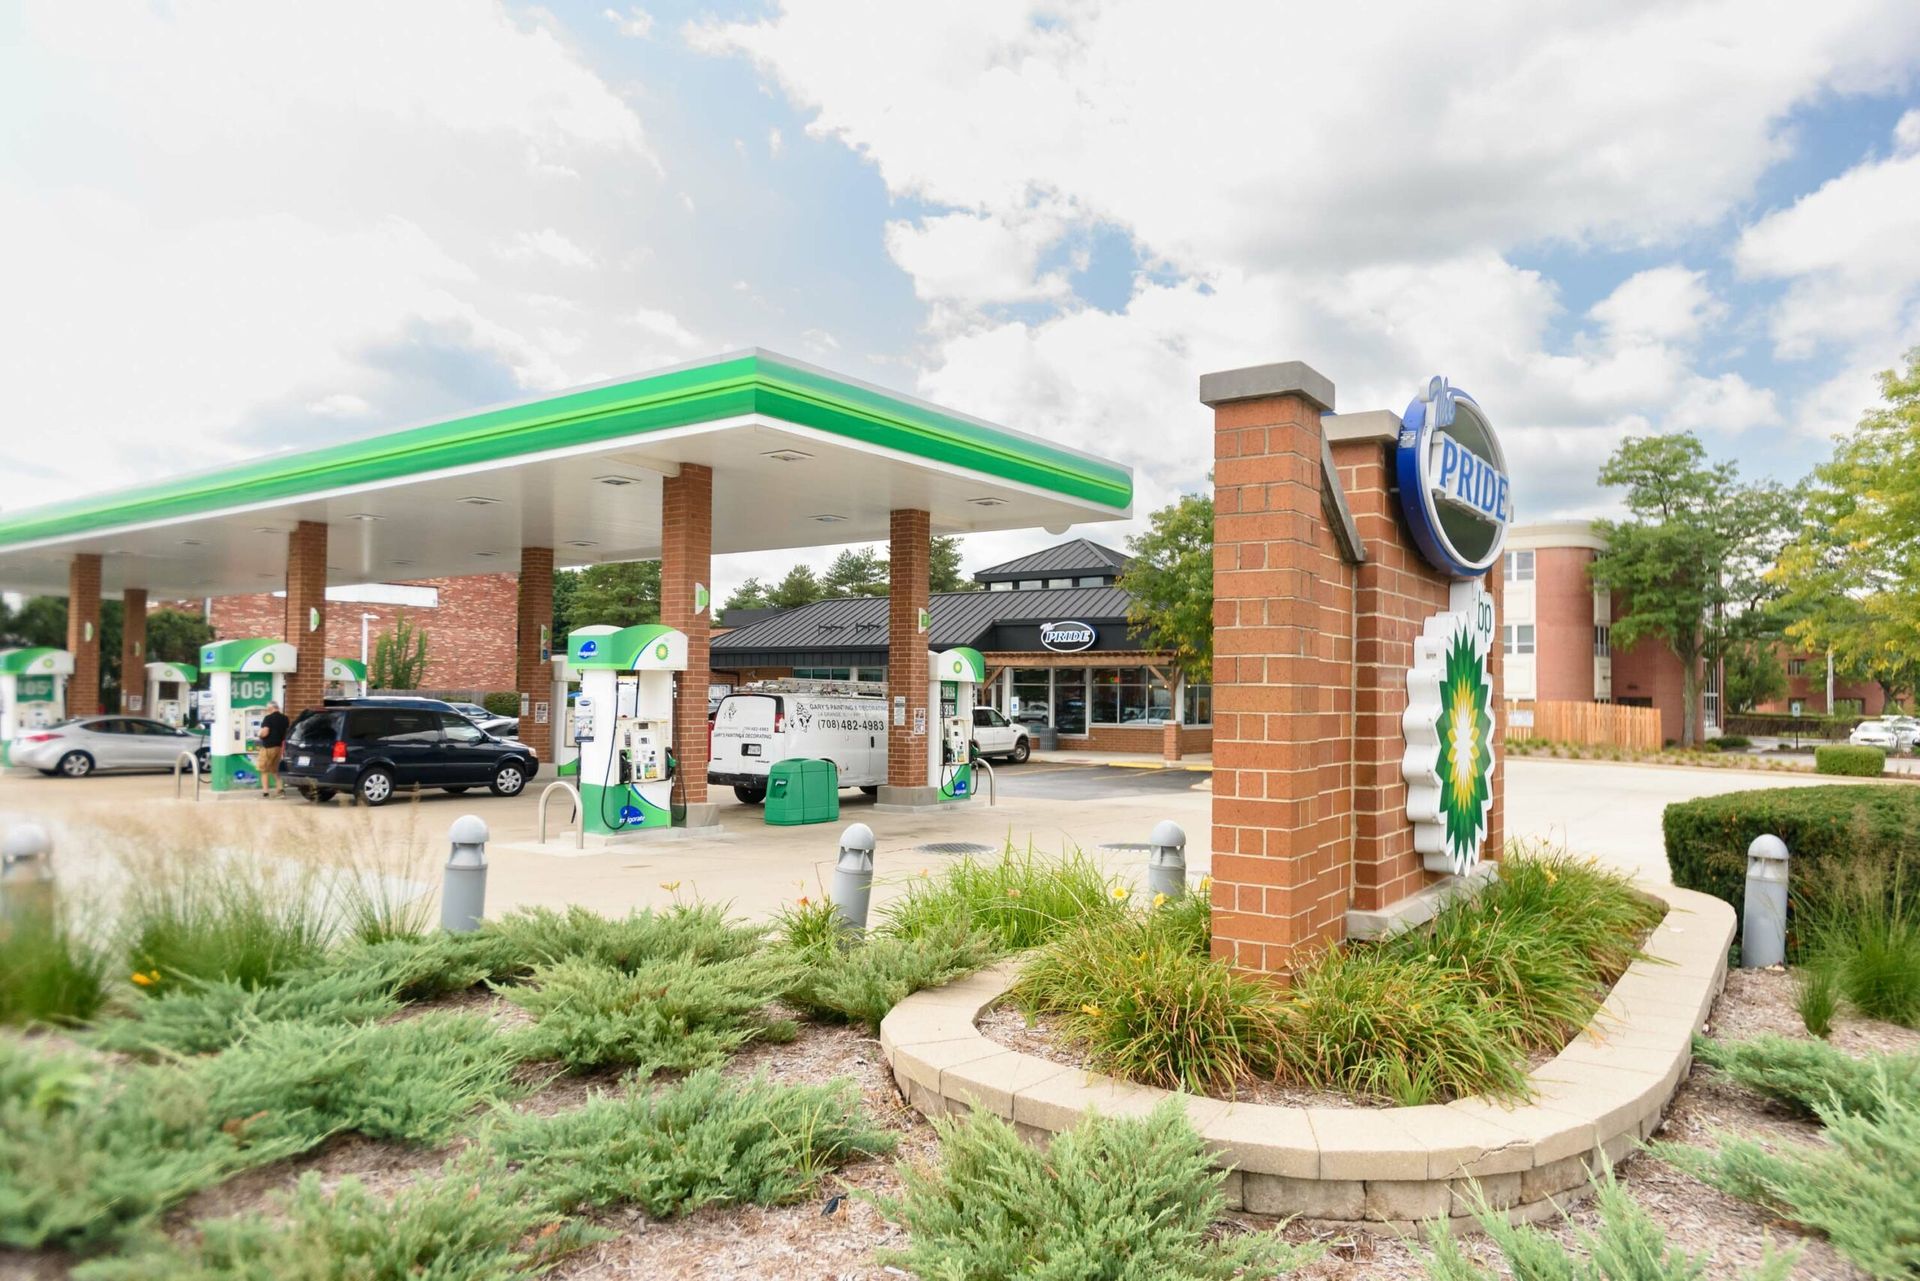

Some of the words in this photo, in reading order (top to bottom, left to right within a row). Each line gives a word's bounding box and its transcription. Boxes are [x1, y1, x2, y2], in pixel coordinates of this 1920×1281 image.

[1440, 437, 1508, 522] PRIDE
[1045, 630, 1091, 643] PRIDE
[1477, 590, 1492, 643] bp
